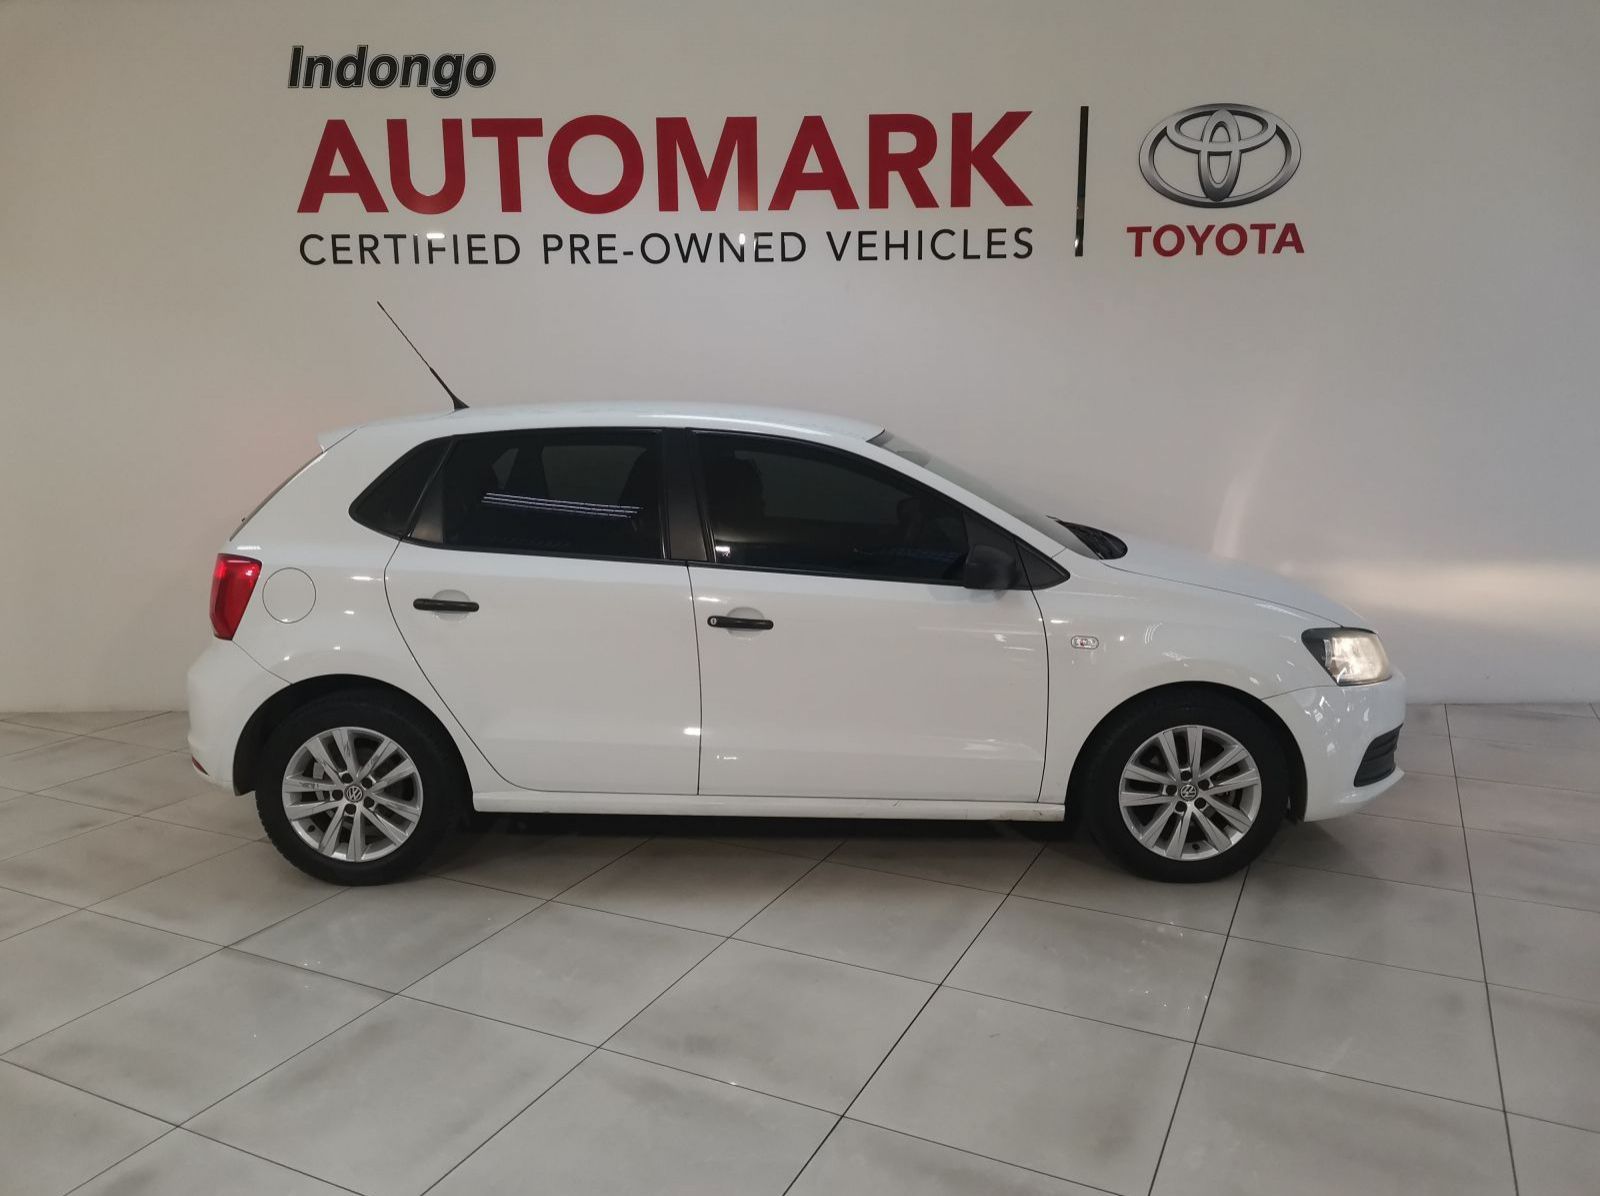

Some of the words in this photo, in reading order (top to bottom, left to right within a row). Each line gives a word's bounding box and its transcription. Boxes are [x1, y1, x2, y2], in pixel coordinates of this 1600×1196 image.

[287, 44, 497, 98] Indongo
[296, 111, 1034, 215] AUTOMARK
[299, 232, 521, 265] CERTIFIED
[542, 232, 807, 264] PRE-OWNED
[826, 227, 1034, 261] VEHICLES
[1126, 223, 1305, 257] TOYOTA
